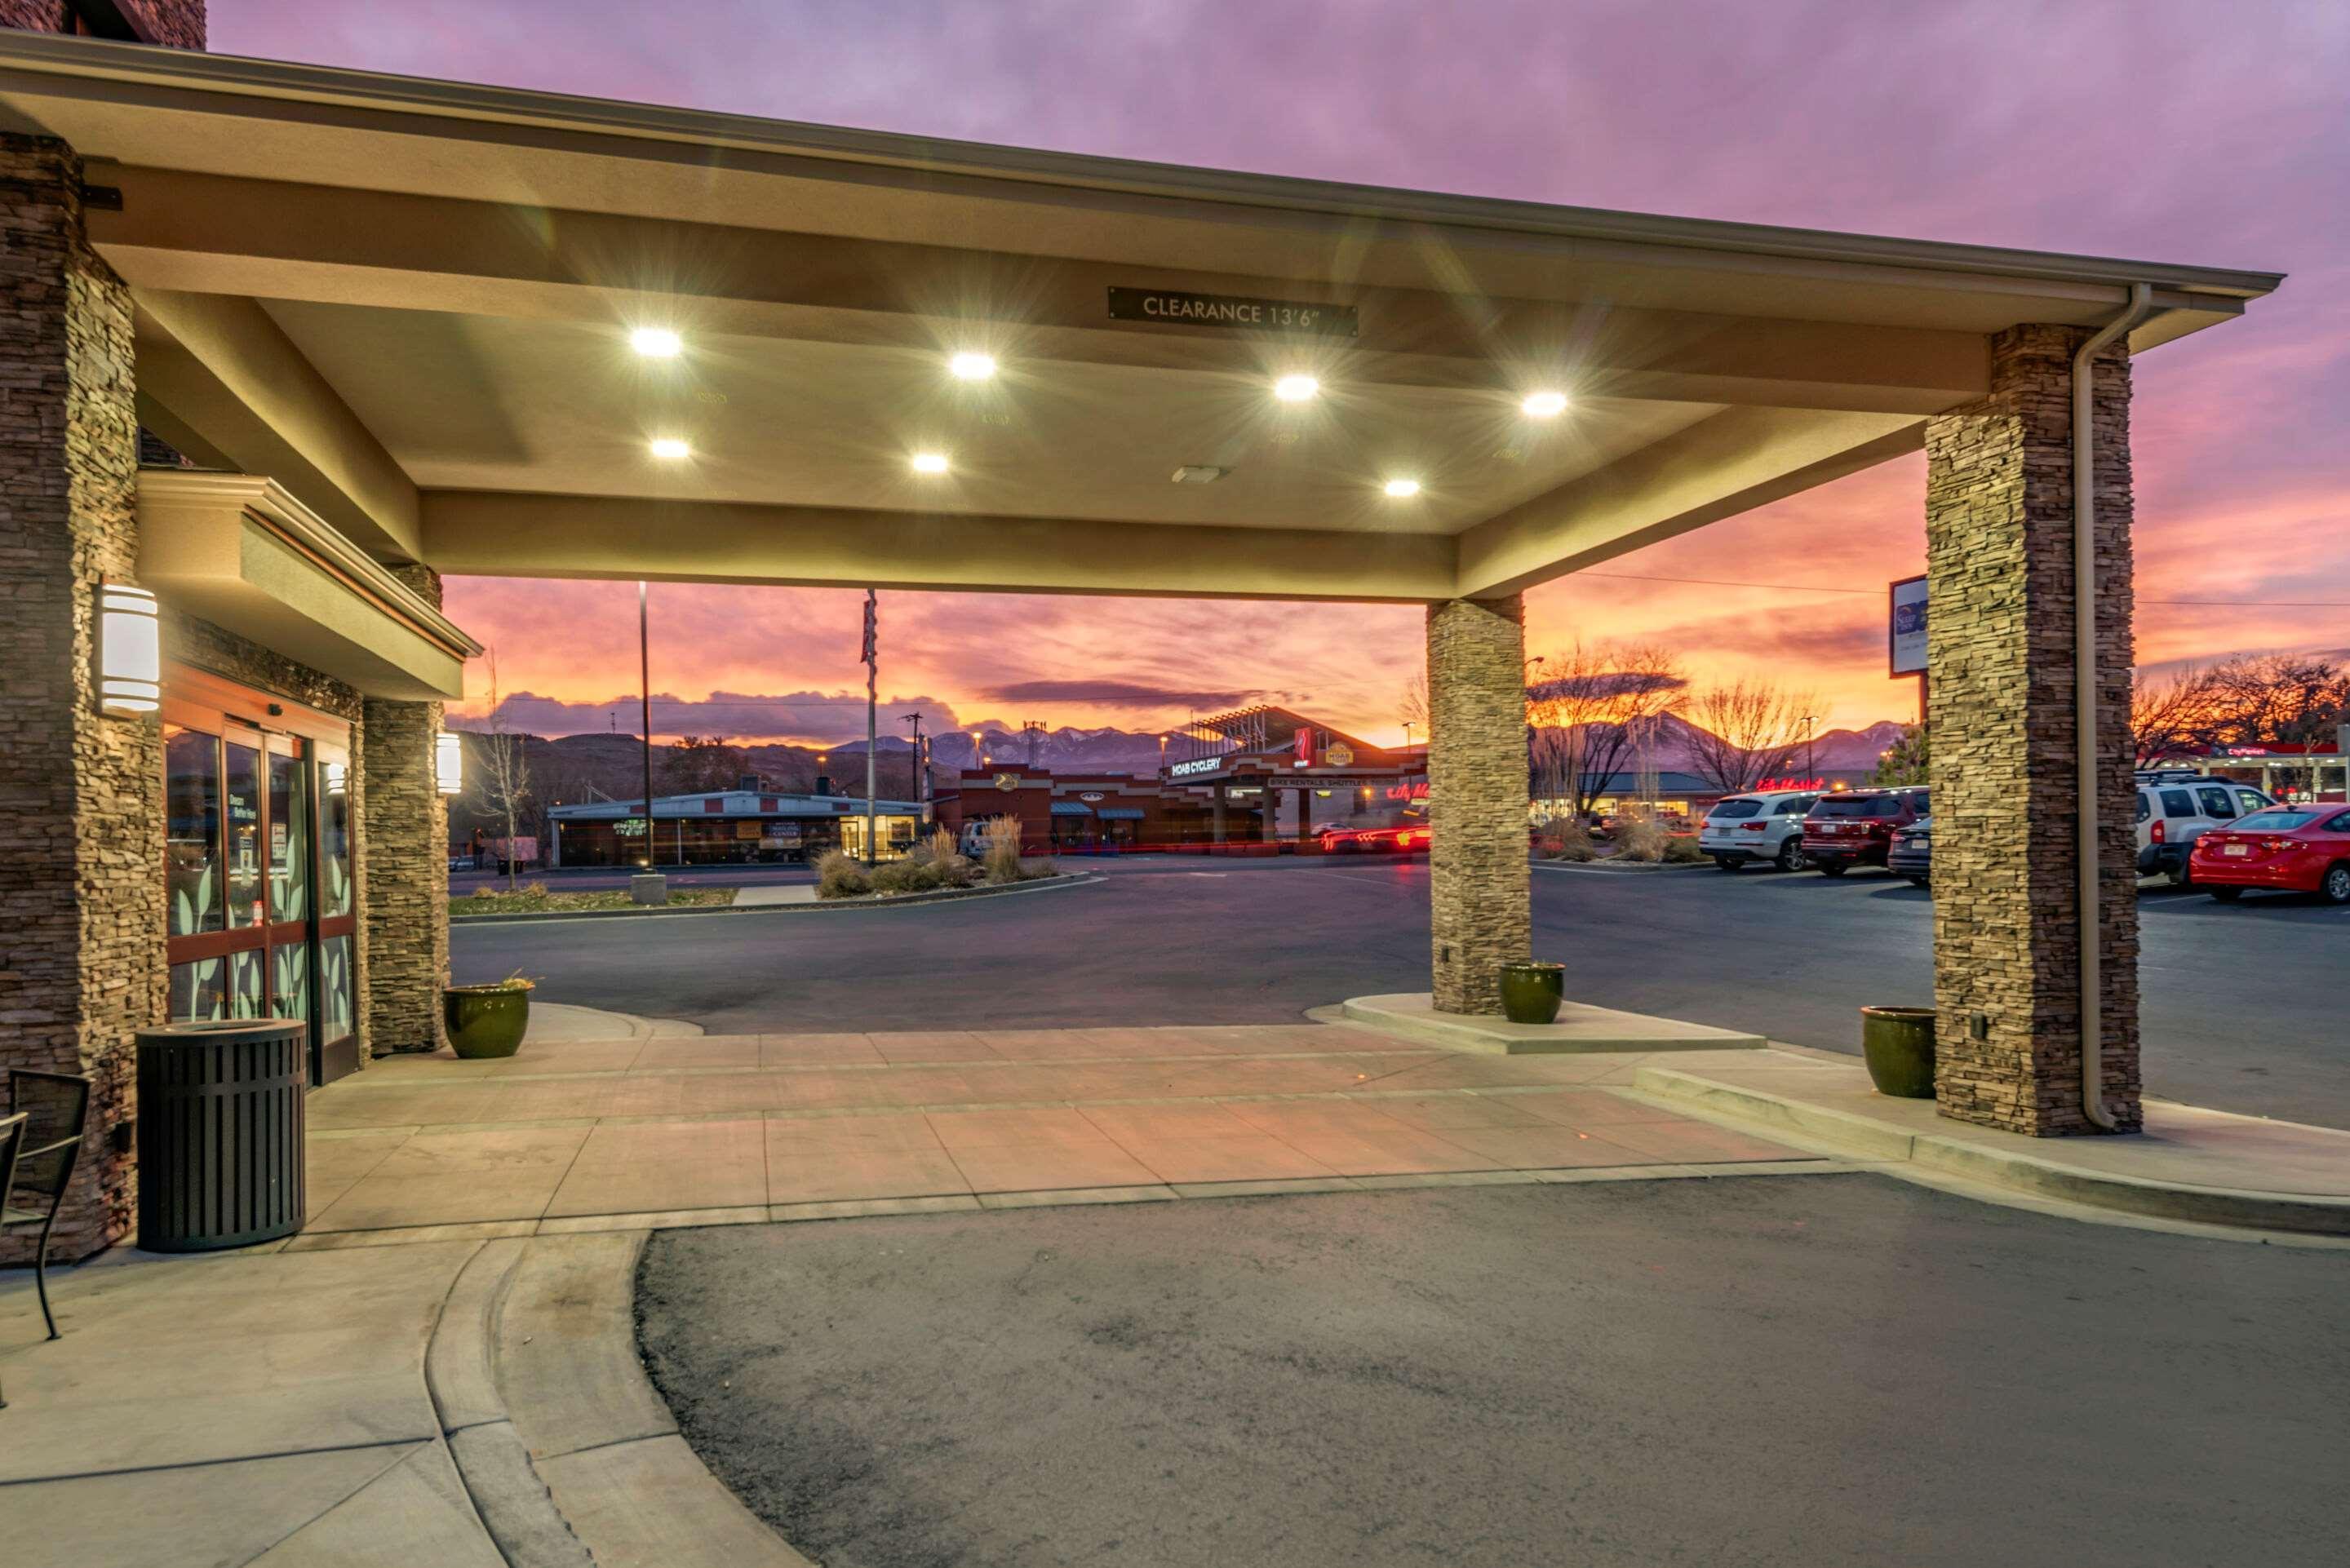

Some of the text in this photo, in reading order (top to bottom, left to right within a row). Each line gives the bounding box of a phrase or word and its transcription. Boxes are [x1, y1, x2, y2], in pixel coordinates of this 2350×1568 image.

[1143, 297, 1261, 323] CLEARANCE
[1897, 614, 1917, 624] SLEEP
[1172, 757, 1222, 777] MOAB CYCLERY
